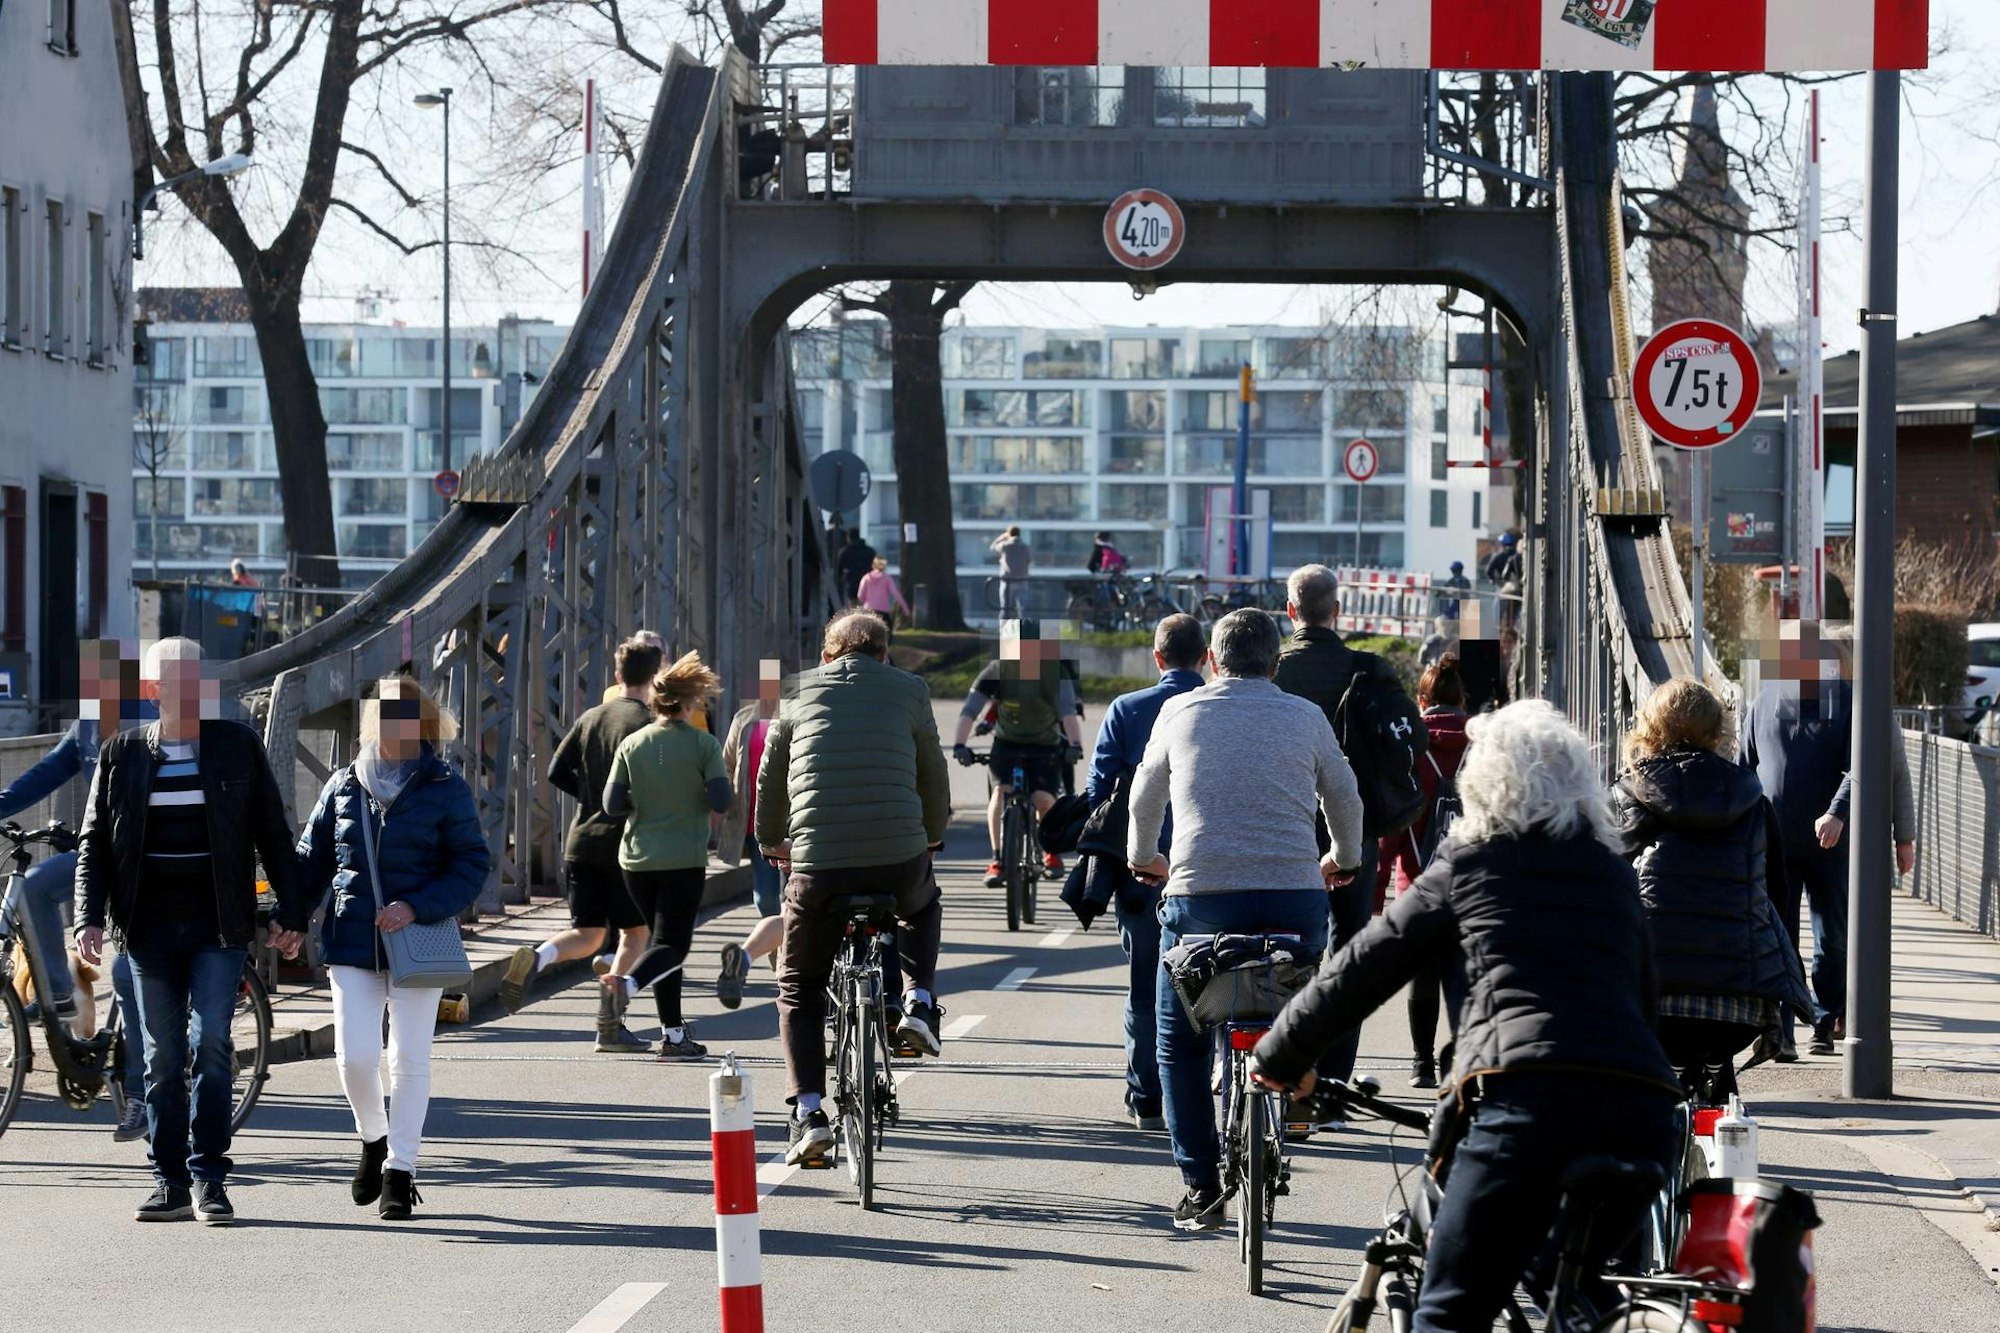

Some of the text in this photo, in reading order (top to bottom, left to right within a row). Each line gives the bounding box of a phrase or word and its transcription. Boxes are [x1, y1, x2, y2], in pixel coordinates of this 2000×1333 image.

[1583, 8, 1600, 26] SPS
[1604, 21, 1627, 33] CGN
[1666, 347, 1689, 359] SPS
[1691, 344, 1714, 357] CGN
